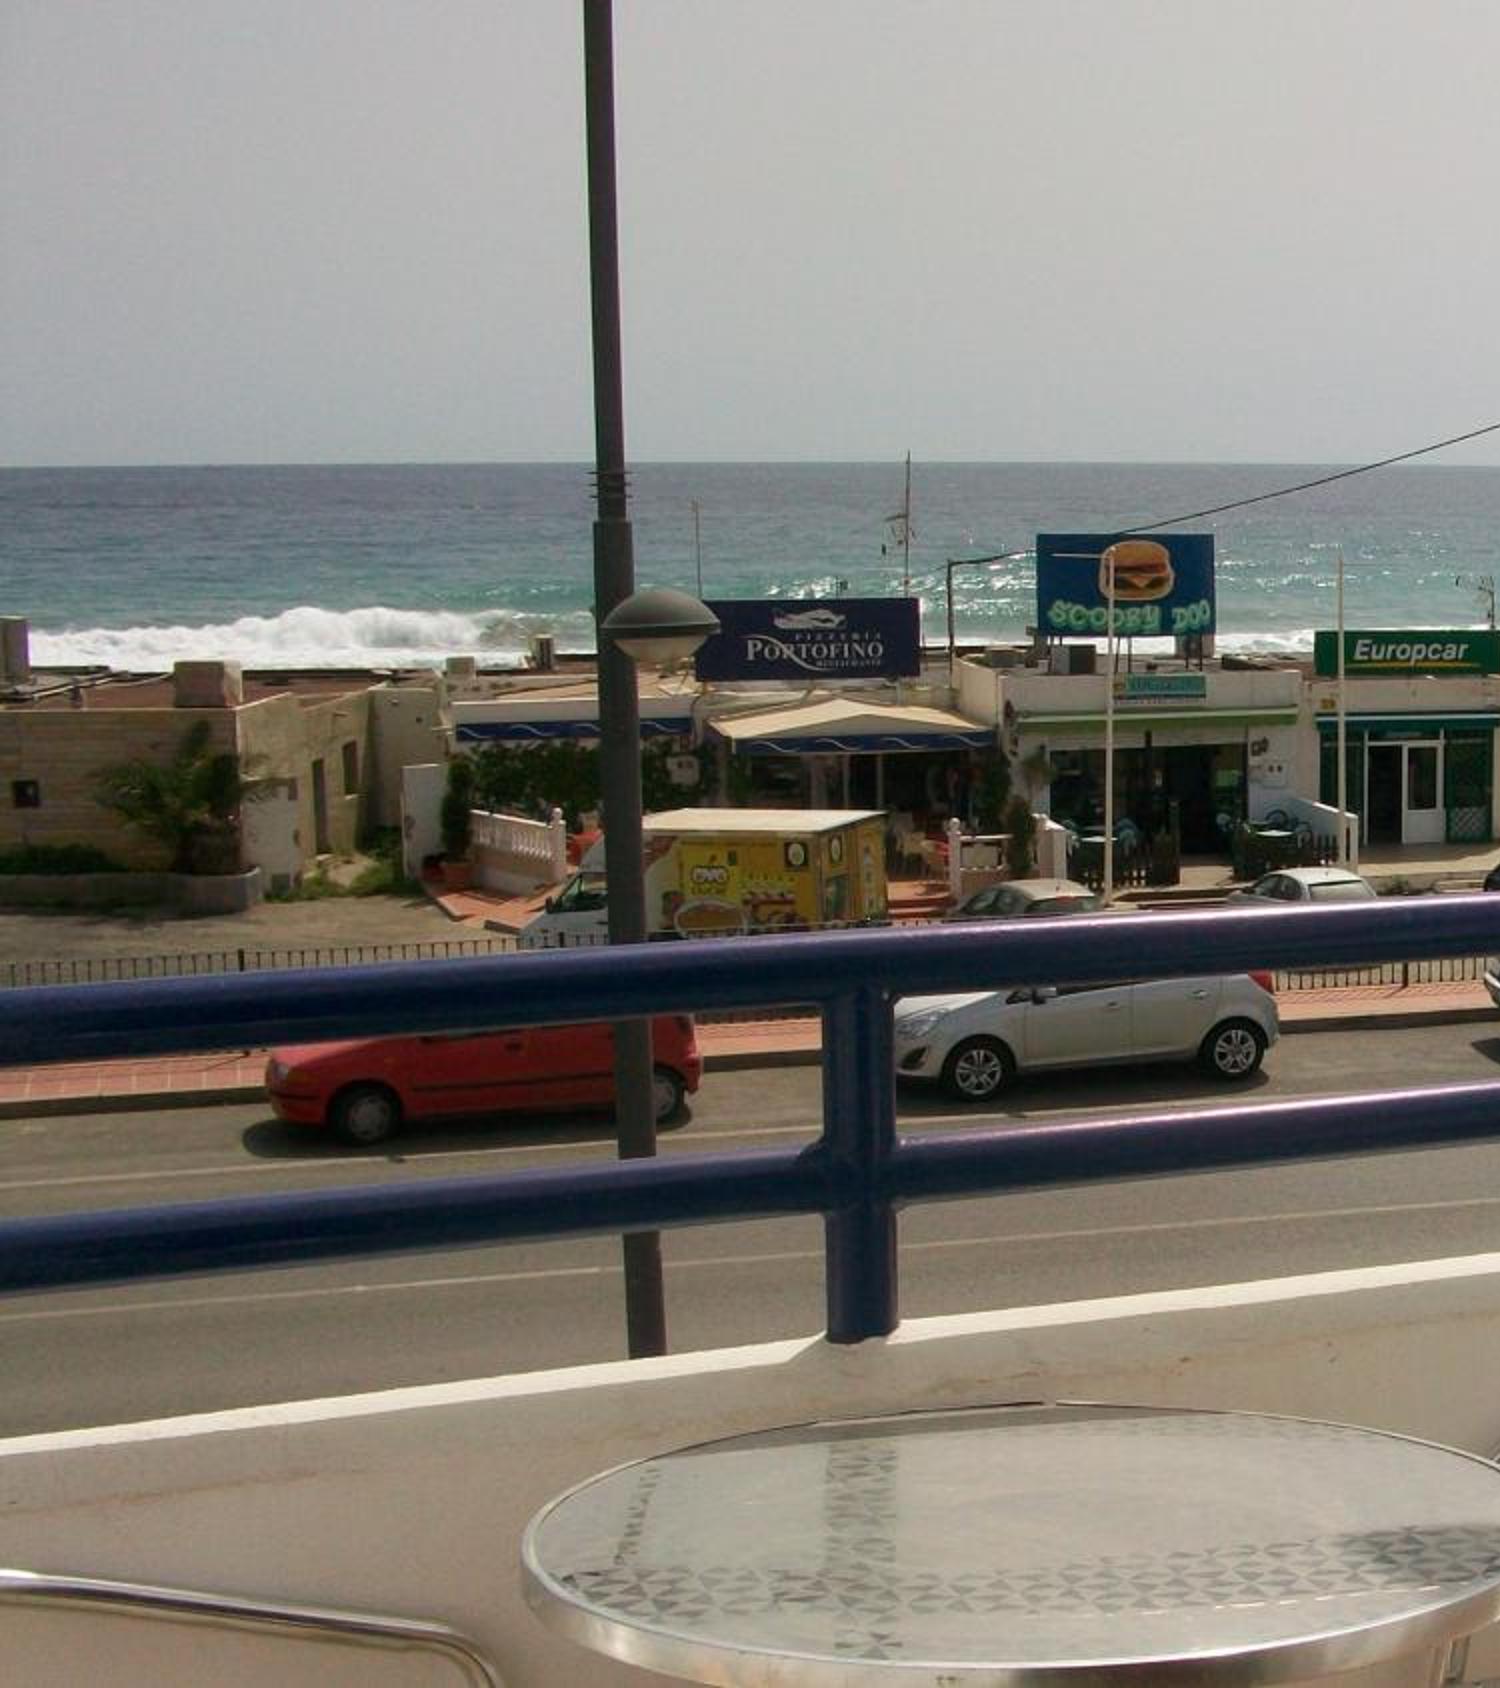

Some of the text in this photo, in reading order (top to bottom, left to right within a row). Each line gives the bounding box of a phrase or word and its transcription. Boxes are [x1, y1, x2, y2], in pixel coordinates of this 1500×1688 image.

[1050, 600, 1211, 632] SCOOBY DOO
[747, 638, 884, 661] PORTOFINO
[1354, 639, 1469, 667] Europcar
